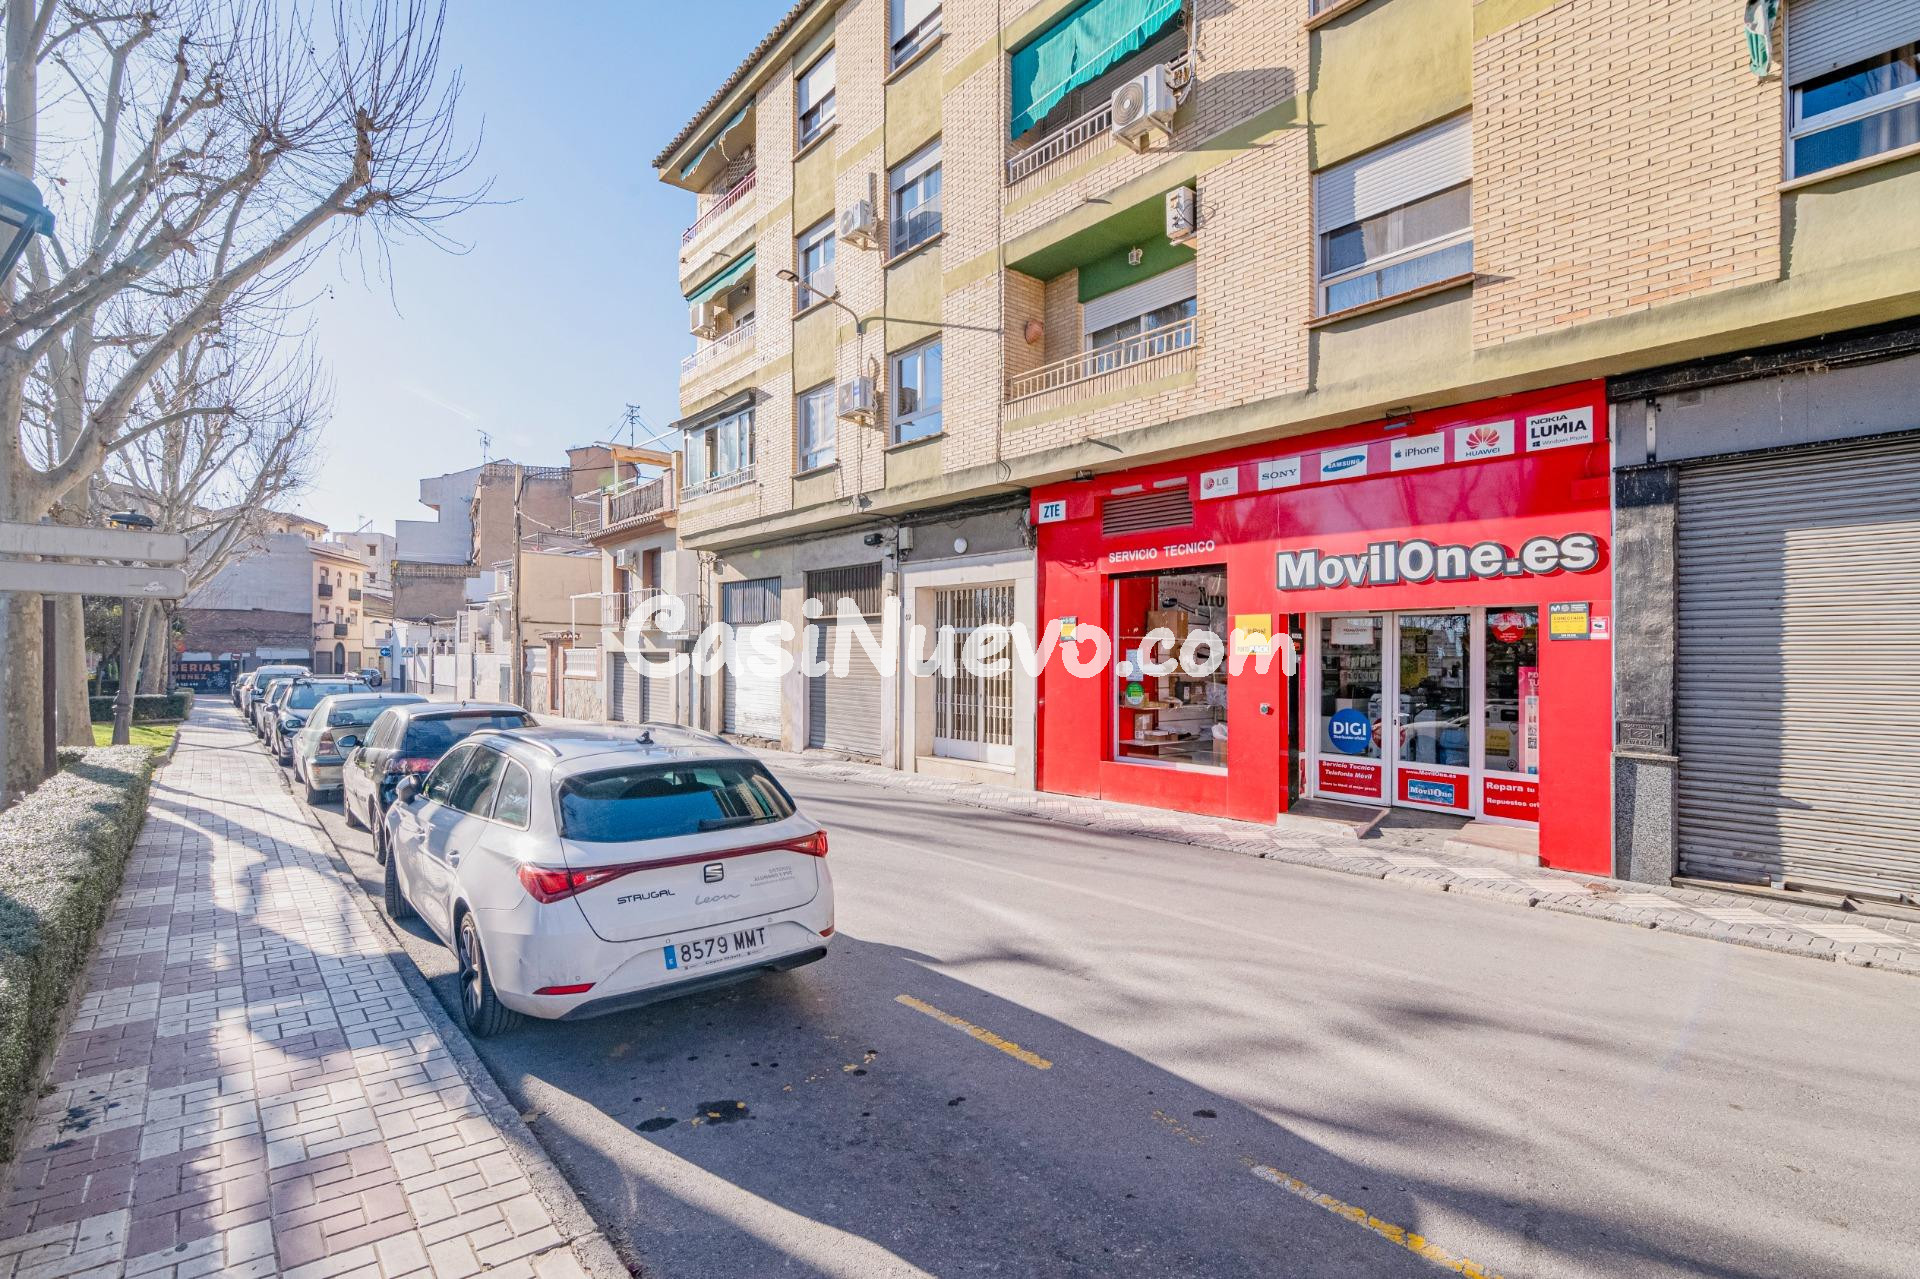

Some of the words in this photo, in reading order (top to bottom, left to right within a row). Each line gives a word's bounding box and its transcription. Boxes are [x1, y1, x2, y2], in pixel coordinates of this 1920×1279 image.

[1530, 414, 1568, 426] NOKIA
[1530, 419, 1587, 439] LUMIA
[1542, 437, 1569, 446] Windows
[1570, 433, 1589, 443] Phone
[1405, 444, 1440, 458] iPhone
[1465, 448, 1501, 457] HUAWEI
[1327, 458, 1361, 470] SAMSUNG
[1261, 468, 1297, 481] SONY
[1216, 477, 1229, 487] LG
[1044, 504, 1060, 519] ZTE
[1108, 548, 1158, 564] SERVICIO
[1163, 540, 1216, 558] TECNICO
[1277, 532, 1599, 591] MovilOne.es
[1333, 721, 1367, 736] DIGI
[1322, 761, 1348, 769] Servicio
[1410, 786, 1453, 798] MovilOne
[1486, 781, 1524, 792] Repara
[1487, 797, 1527, 807] Repuestos
[617, 889, 676, 905] STRUGAL
[694, 891, 742, 906] Leon
[681, 935, 729, 963] 8579
[733, 927, 766, 952] MMT
